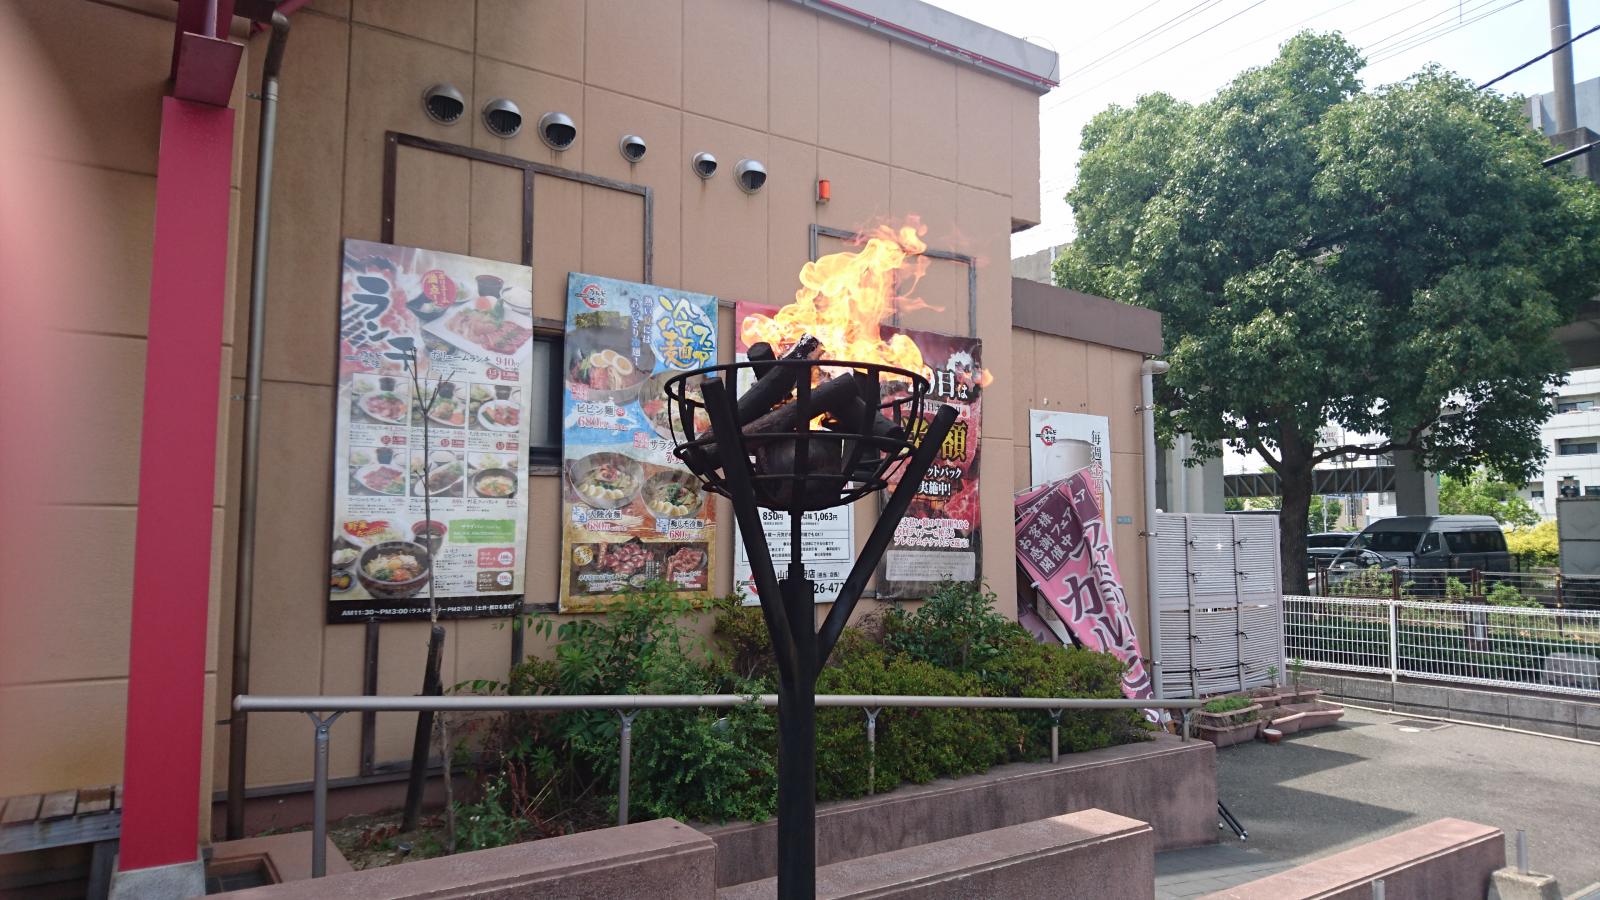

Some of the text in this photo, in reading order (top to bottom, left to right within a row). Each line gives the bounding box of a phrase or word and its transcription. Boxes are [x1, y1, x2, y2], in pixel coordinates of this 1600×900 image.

[577, 403, 615, 417] ビビン麺
[588, 510, 622, 519] 大陸冷麺
[763, 512, 784, 521] 850円
[814, 512, 838, 521] 1,063円
[1019, 512, 1054, 550] お客様
[1030, 506, 1075, 563] 感謝フェア
[1040, 533, 1073, 572] 開催中
